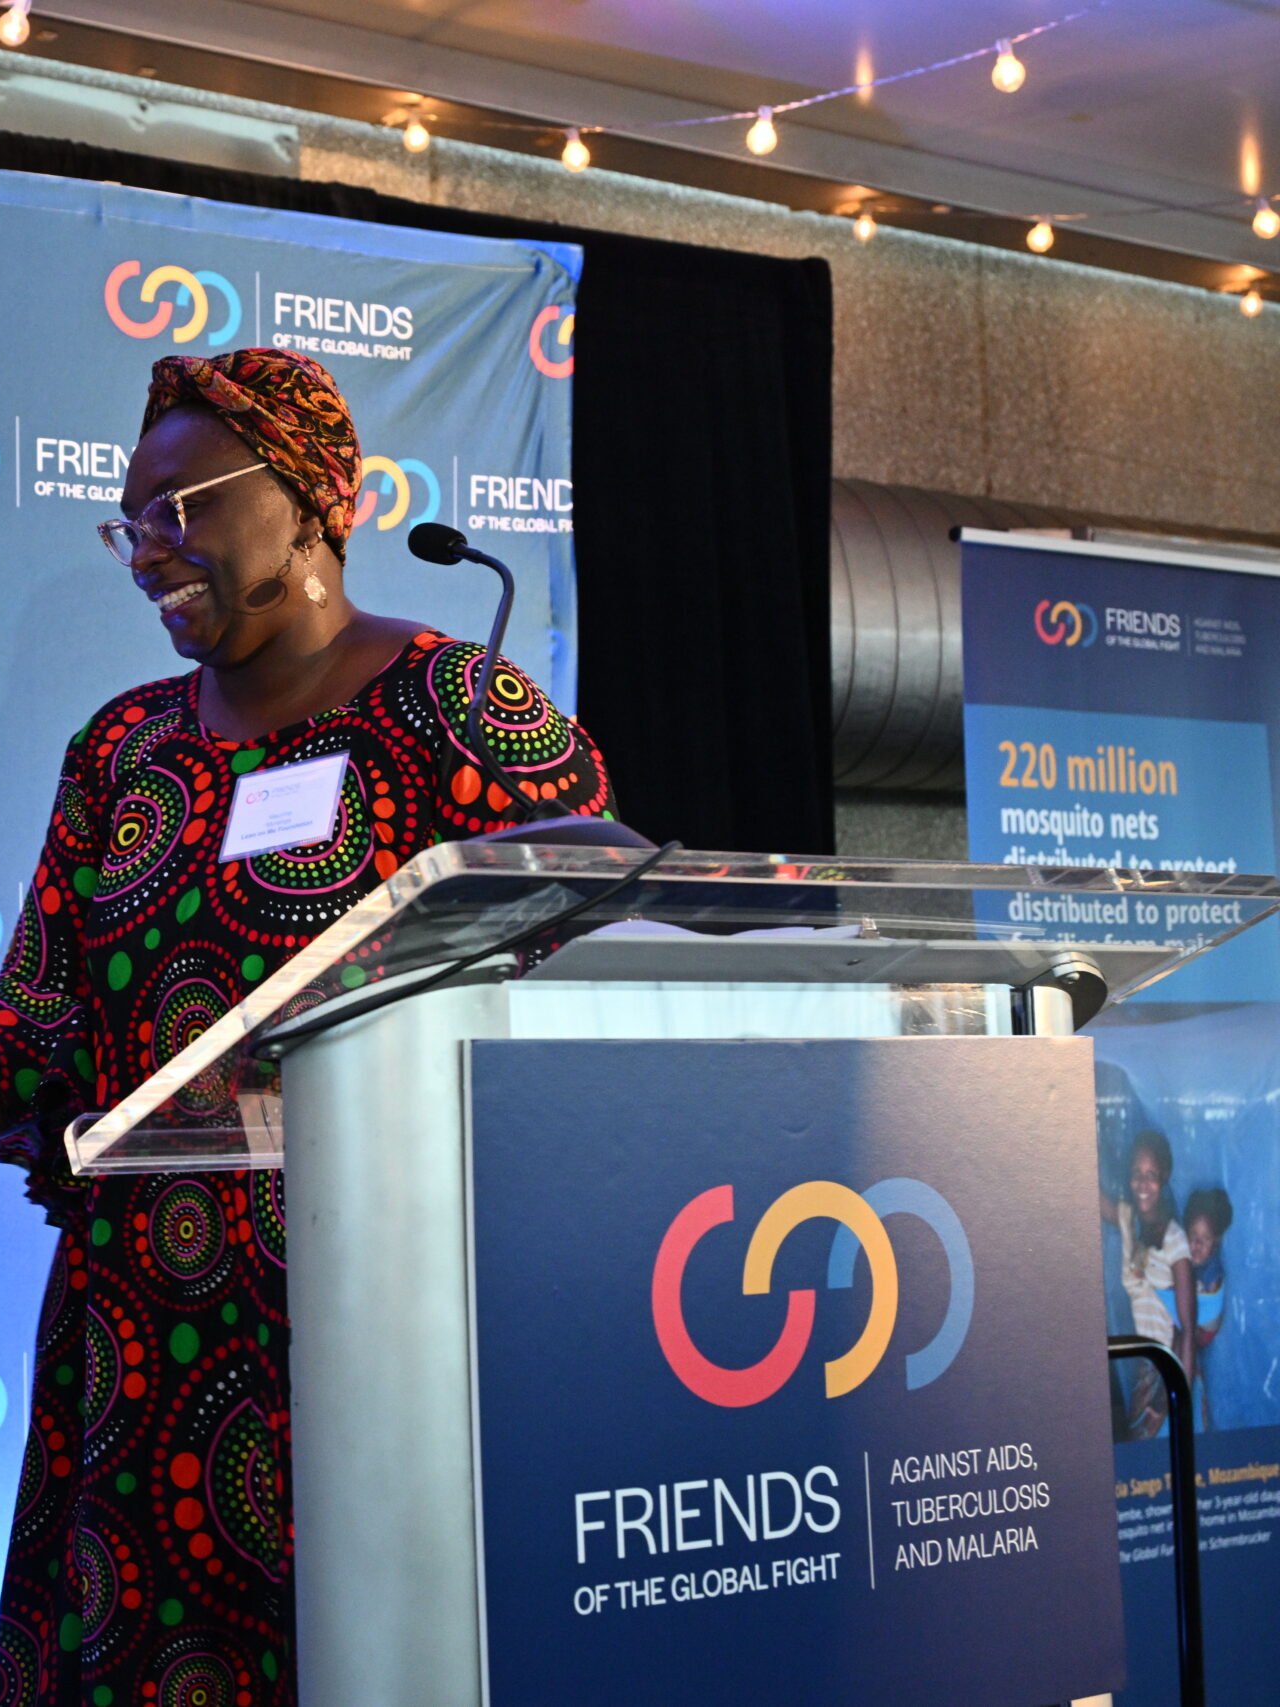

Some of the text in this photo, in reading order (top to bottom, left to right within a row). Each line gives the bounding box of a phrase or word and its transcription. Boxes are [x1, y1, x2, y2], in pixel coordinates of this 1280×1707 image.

[274, 291, 414, 340] FRIENDS
[272, 332, 413, 361] OF THE GLOBAL FIGHT
[34, 480, 56, 496] OF
[56, 482, 86, 500] THE
[470, 474, 573, 512] FRIEND
[468, 515, 486, 529] OF
[487, 516, 511, 531] THE
[512, 517, 557, 533] GLOBAL
[1105, 607, 1181, 638] FRIENDS
[998, 741, 1178, 796] 220 million
[1000, 803, 1159, 846] mosquito nets
[1008, 892, 1242, 932] distributed to protect
[890, 1443, 1038, 1486] AGAINST AIDS,
[575, 1465, 841, 1564] FRIENDS
[891, 1482, 1050, 1527] TUBERCULOSIS
[895, 1526, 1039, 1571] AND MALARIA
[573, 1553, 841, 1616] OF THE GLOBAL FIGHT
